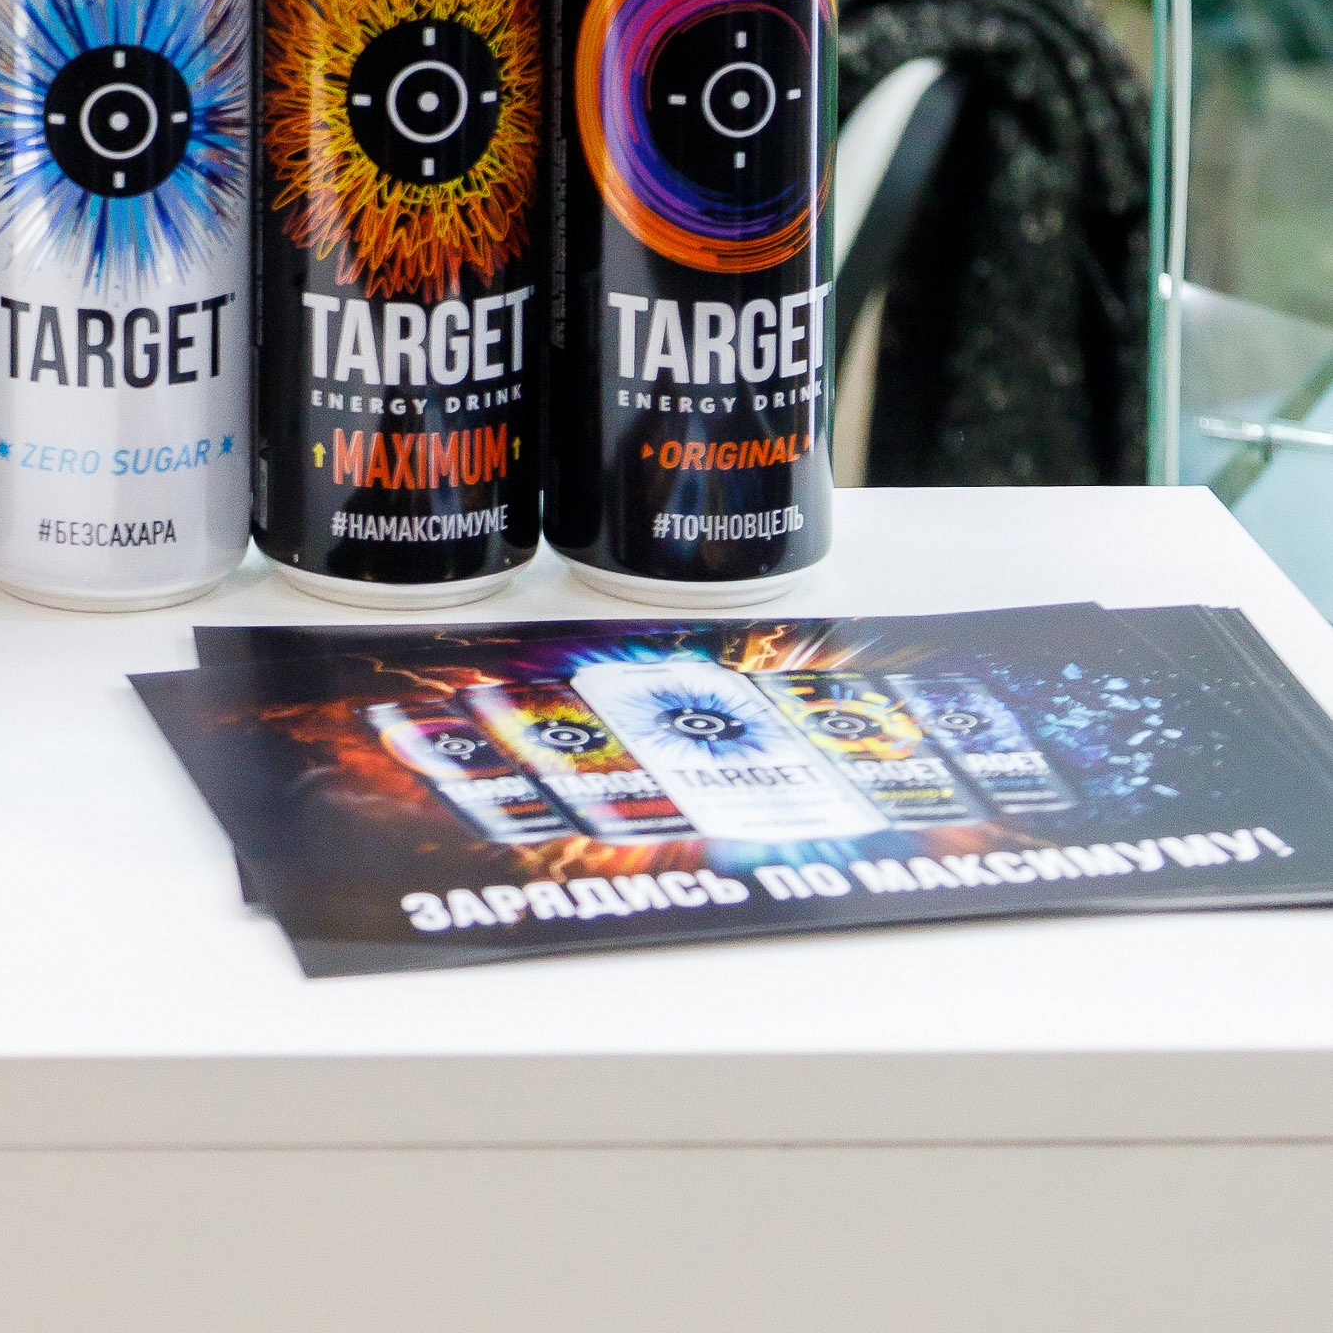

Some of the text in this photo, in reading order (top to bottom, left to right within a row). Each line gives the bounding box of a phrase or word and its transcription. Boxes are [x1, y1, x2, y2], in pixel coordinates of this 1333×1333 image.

[0, 294, 228, 389] TARGET
[302, 286, 531, 386] TARGET
[608, 281, 833, 385] TARGET
[310, 384, 522, 416] ENERGY DRINK
[617, 379, 823, 414] ENERGY DRINK
[20, 438, 212, 476] ZERO SUGAR
[332, 423, 508, 489] MAXIMUM
[657, 433, 801, 471] ORIGINAL
[38, 518, 177, 547] #БЕЗСАХАРА
[330, 504, 509, 542] #НАМАКСИМУМЕ
[652, 504, 805, 541] #ТОЧНОВЦЕЛЬ
[671, 764, 822, 789] TARGET
[400, 826, 1295, 932] ЗАРЯДИСЬ ПО МАКСИМУМУ!
